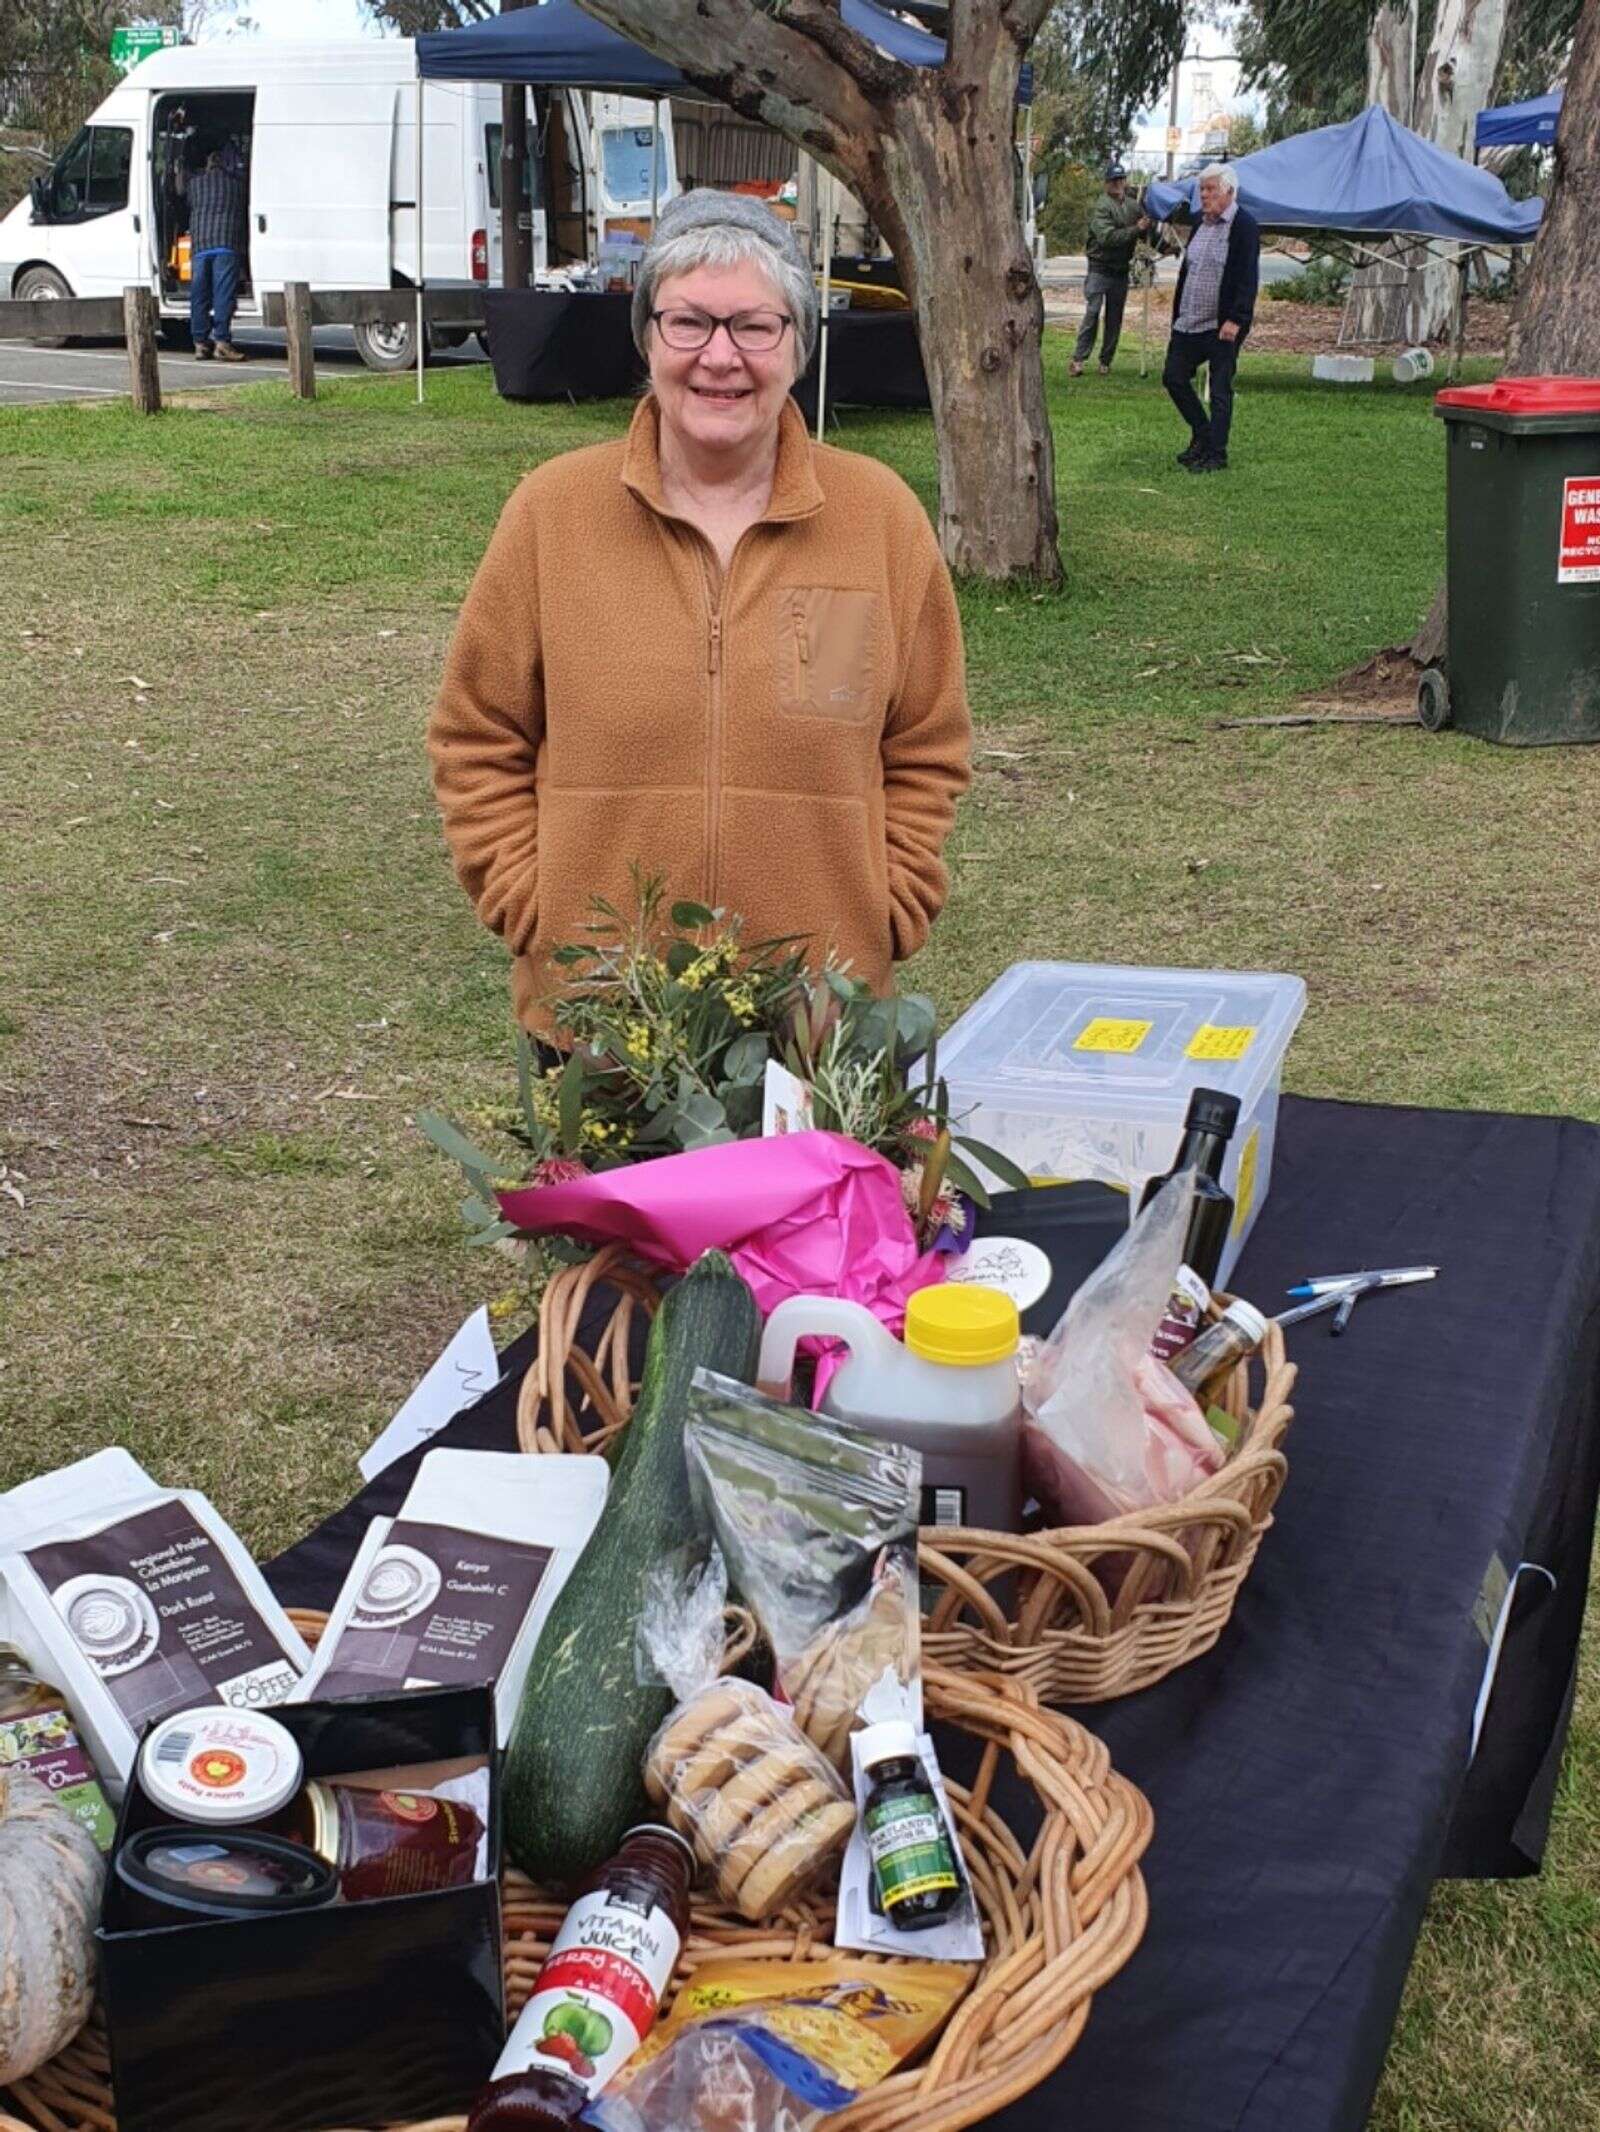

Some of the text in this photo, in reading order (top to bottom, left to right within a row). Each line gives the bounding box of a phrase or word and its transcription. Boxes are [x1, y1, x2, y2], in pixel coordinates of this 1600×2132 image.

[455, 1559, 490, 1574] Kenya
[159, 1591, 215, 1618] Dark Roast
[229, 1671, 298, 1708] COFFEE
[577, 1913, 661, 1957] VITAMIN
[580, 1930, 644, 1965] JUICE
